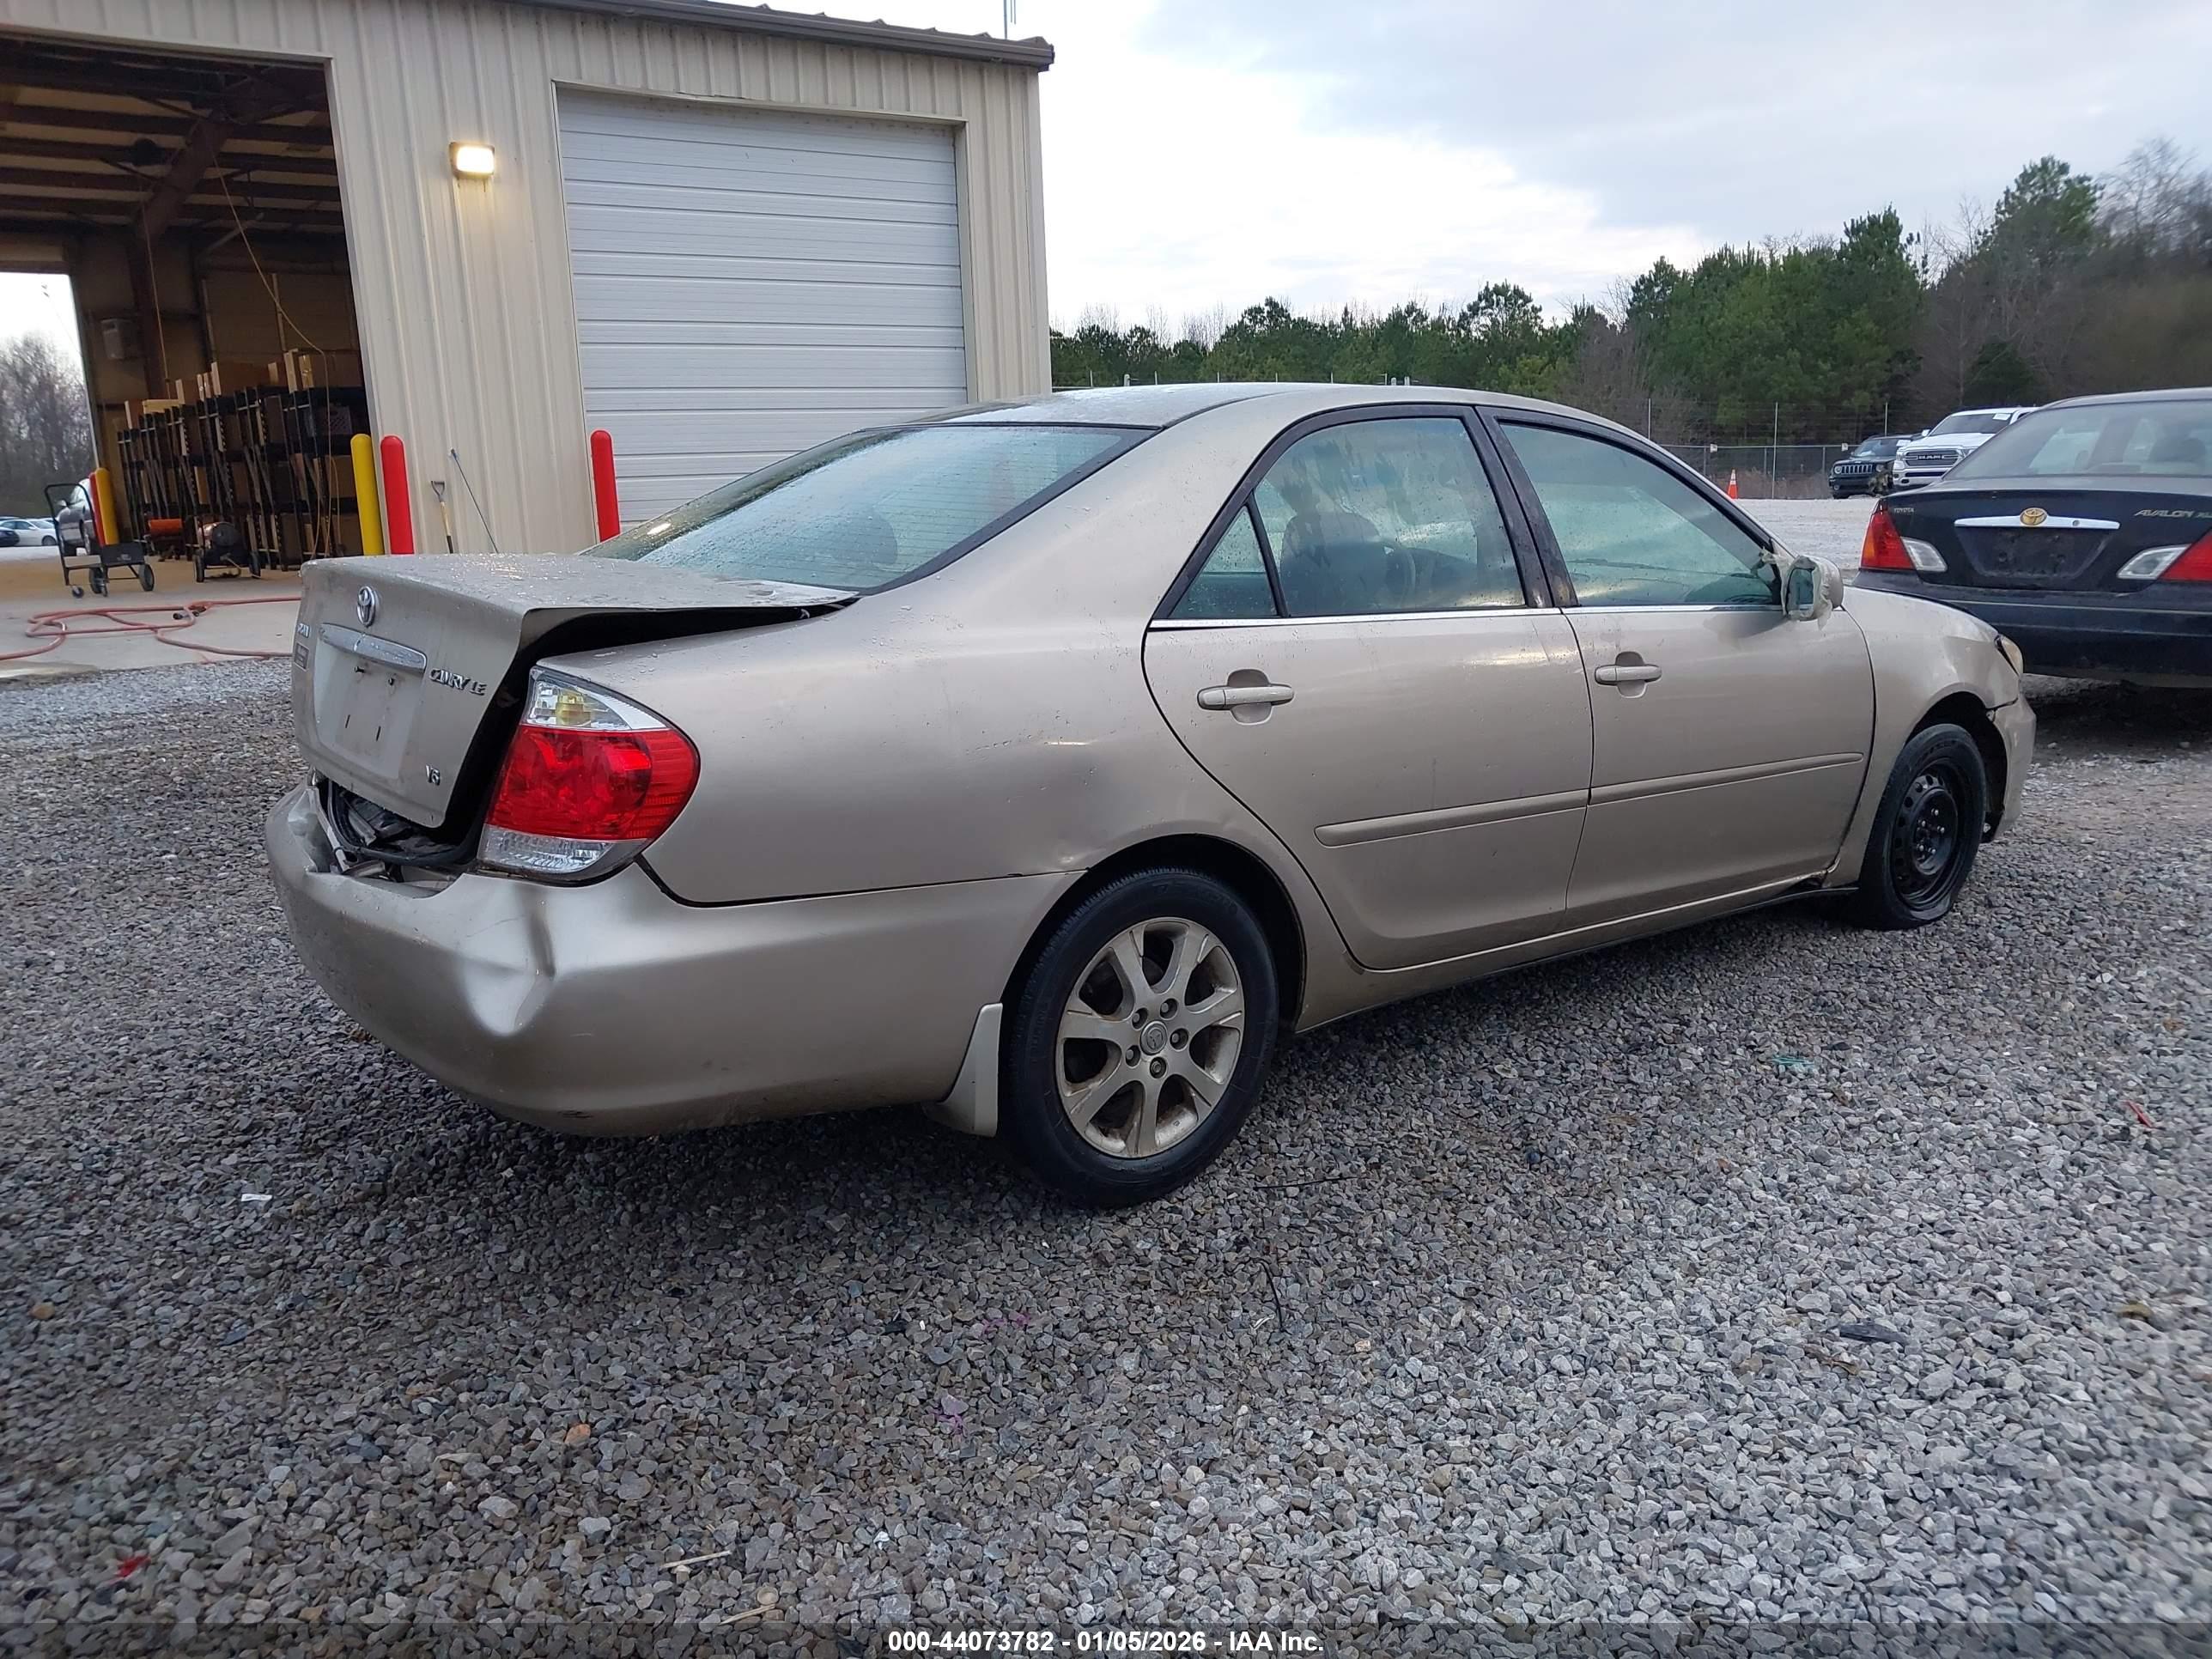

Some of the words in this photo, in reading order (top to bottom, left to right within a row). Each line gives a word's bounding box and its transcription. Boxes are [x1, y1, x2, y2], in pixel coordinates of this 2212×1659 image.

[2133, 509, 2195, 520] AVALON
[428, 667, 471, 691] CAMRY
[469, 680, 488, 696] LE
[425, 763, 441, 786] V6
